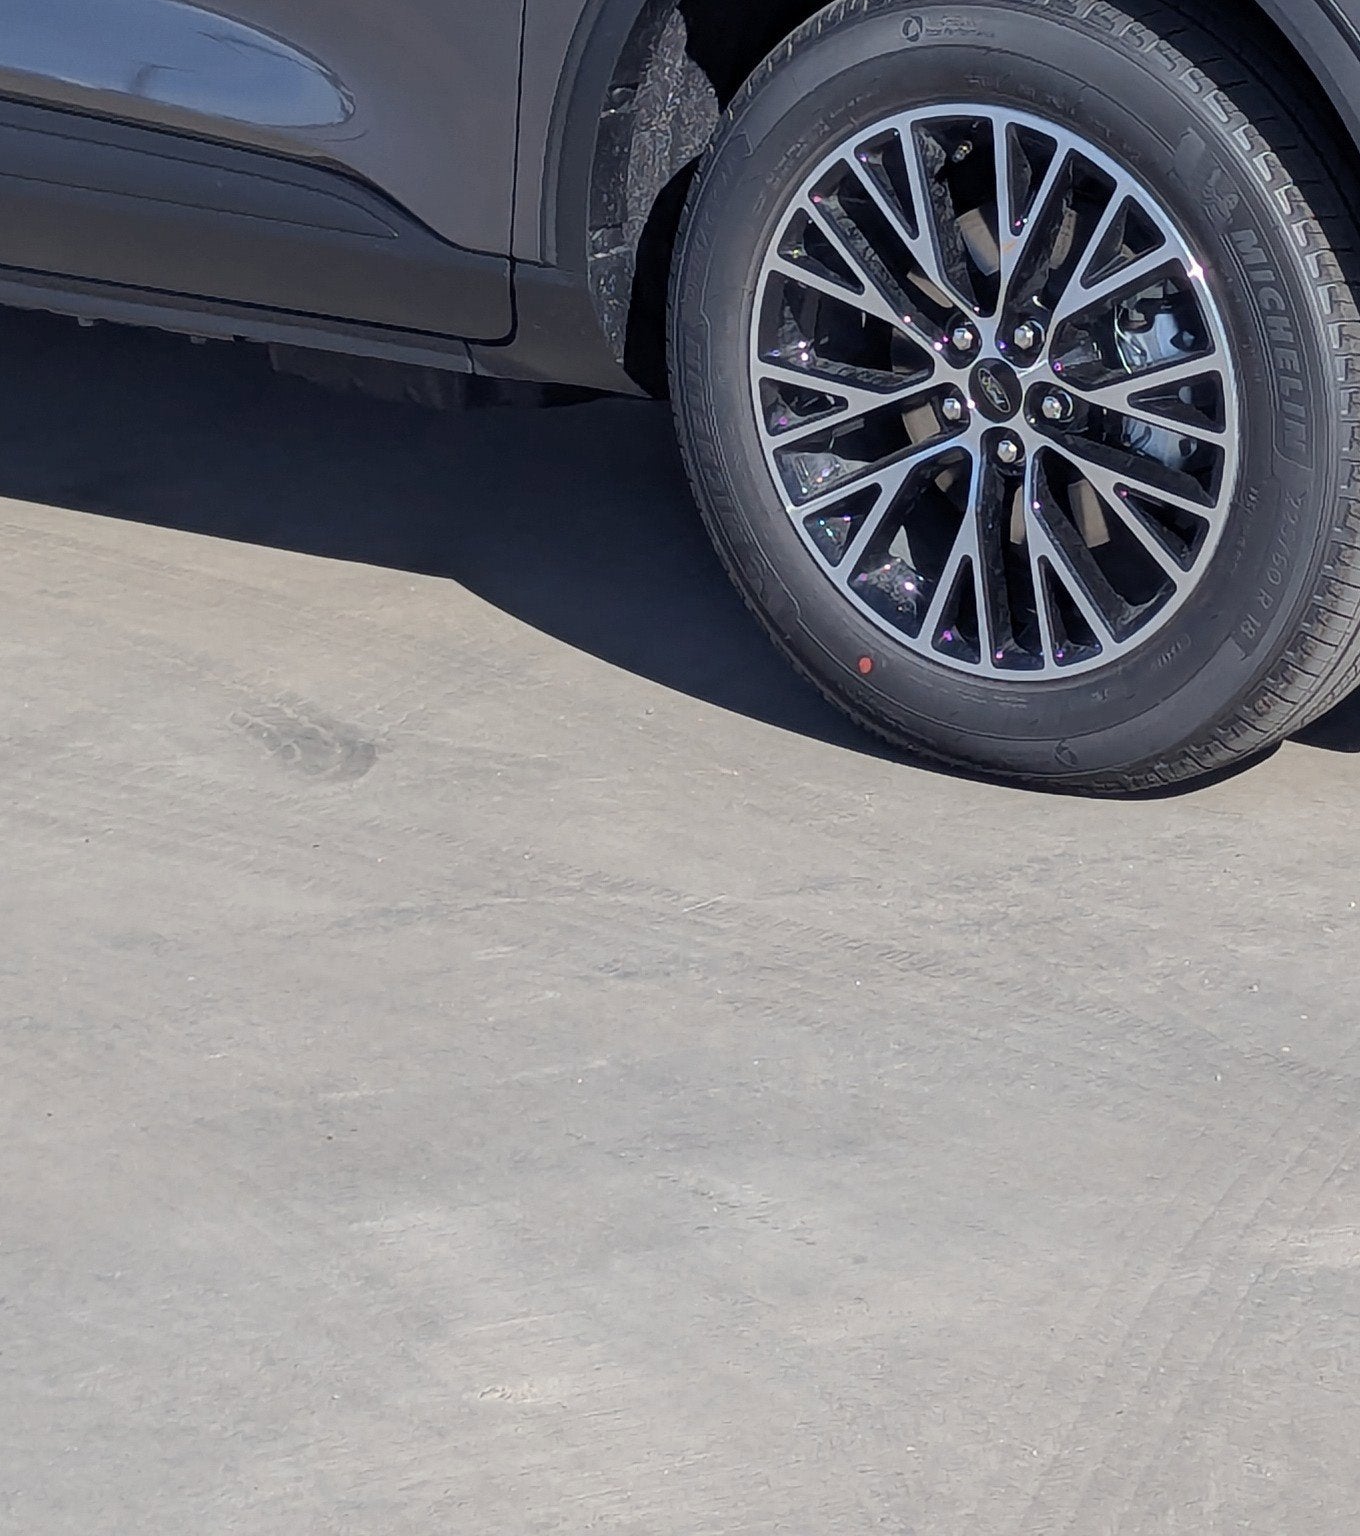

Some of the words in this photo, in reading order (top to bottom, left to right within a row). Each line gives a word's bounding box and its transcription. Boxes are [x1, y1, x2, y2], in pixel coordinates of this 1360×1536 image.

[1230, 228, 1307, 458] MICHELIN
[1257, 587, 1274, 610] R
[1240, 613, 1262, 641] 18
